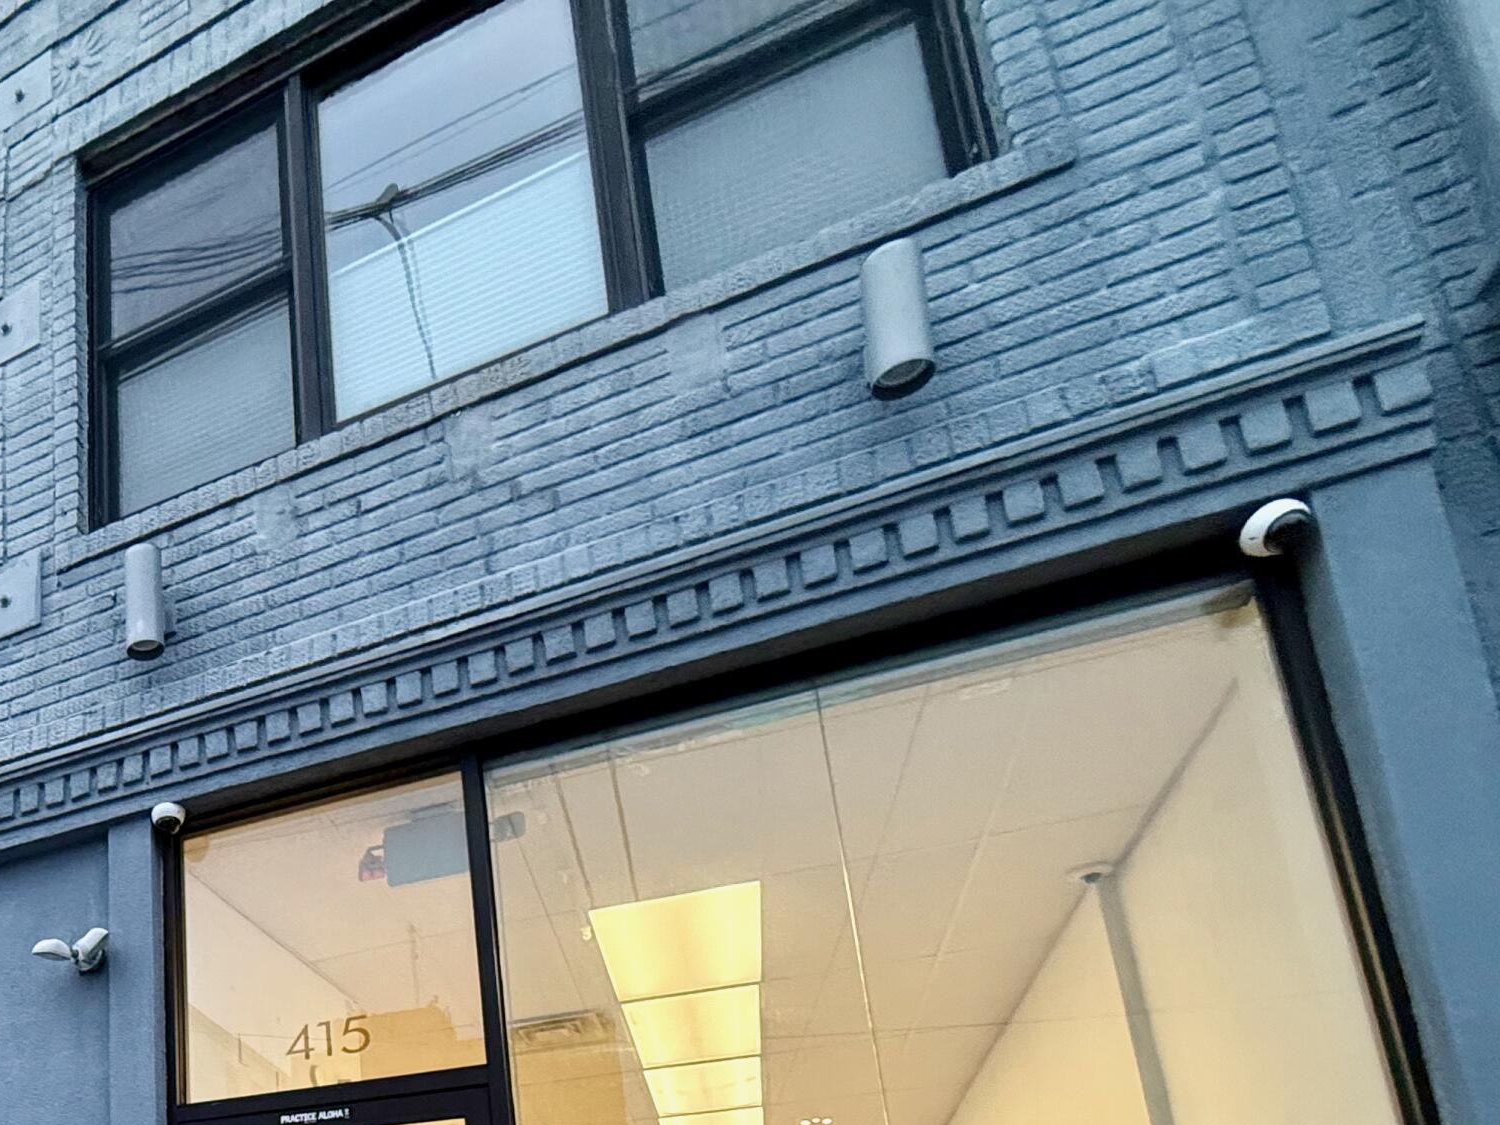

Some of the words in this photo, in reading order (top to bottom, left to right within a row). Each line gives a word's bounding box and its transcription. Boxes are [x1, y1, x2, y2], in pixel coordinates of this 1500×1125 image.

[286, 1014, 371, 1060] 415
[280, 1112, 317, 1125] PRACTICE
[318, 1108, 344, 1121] ALOHA
